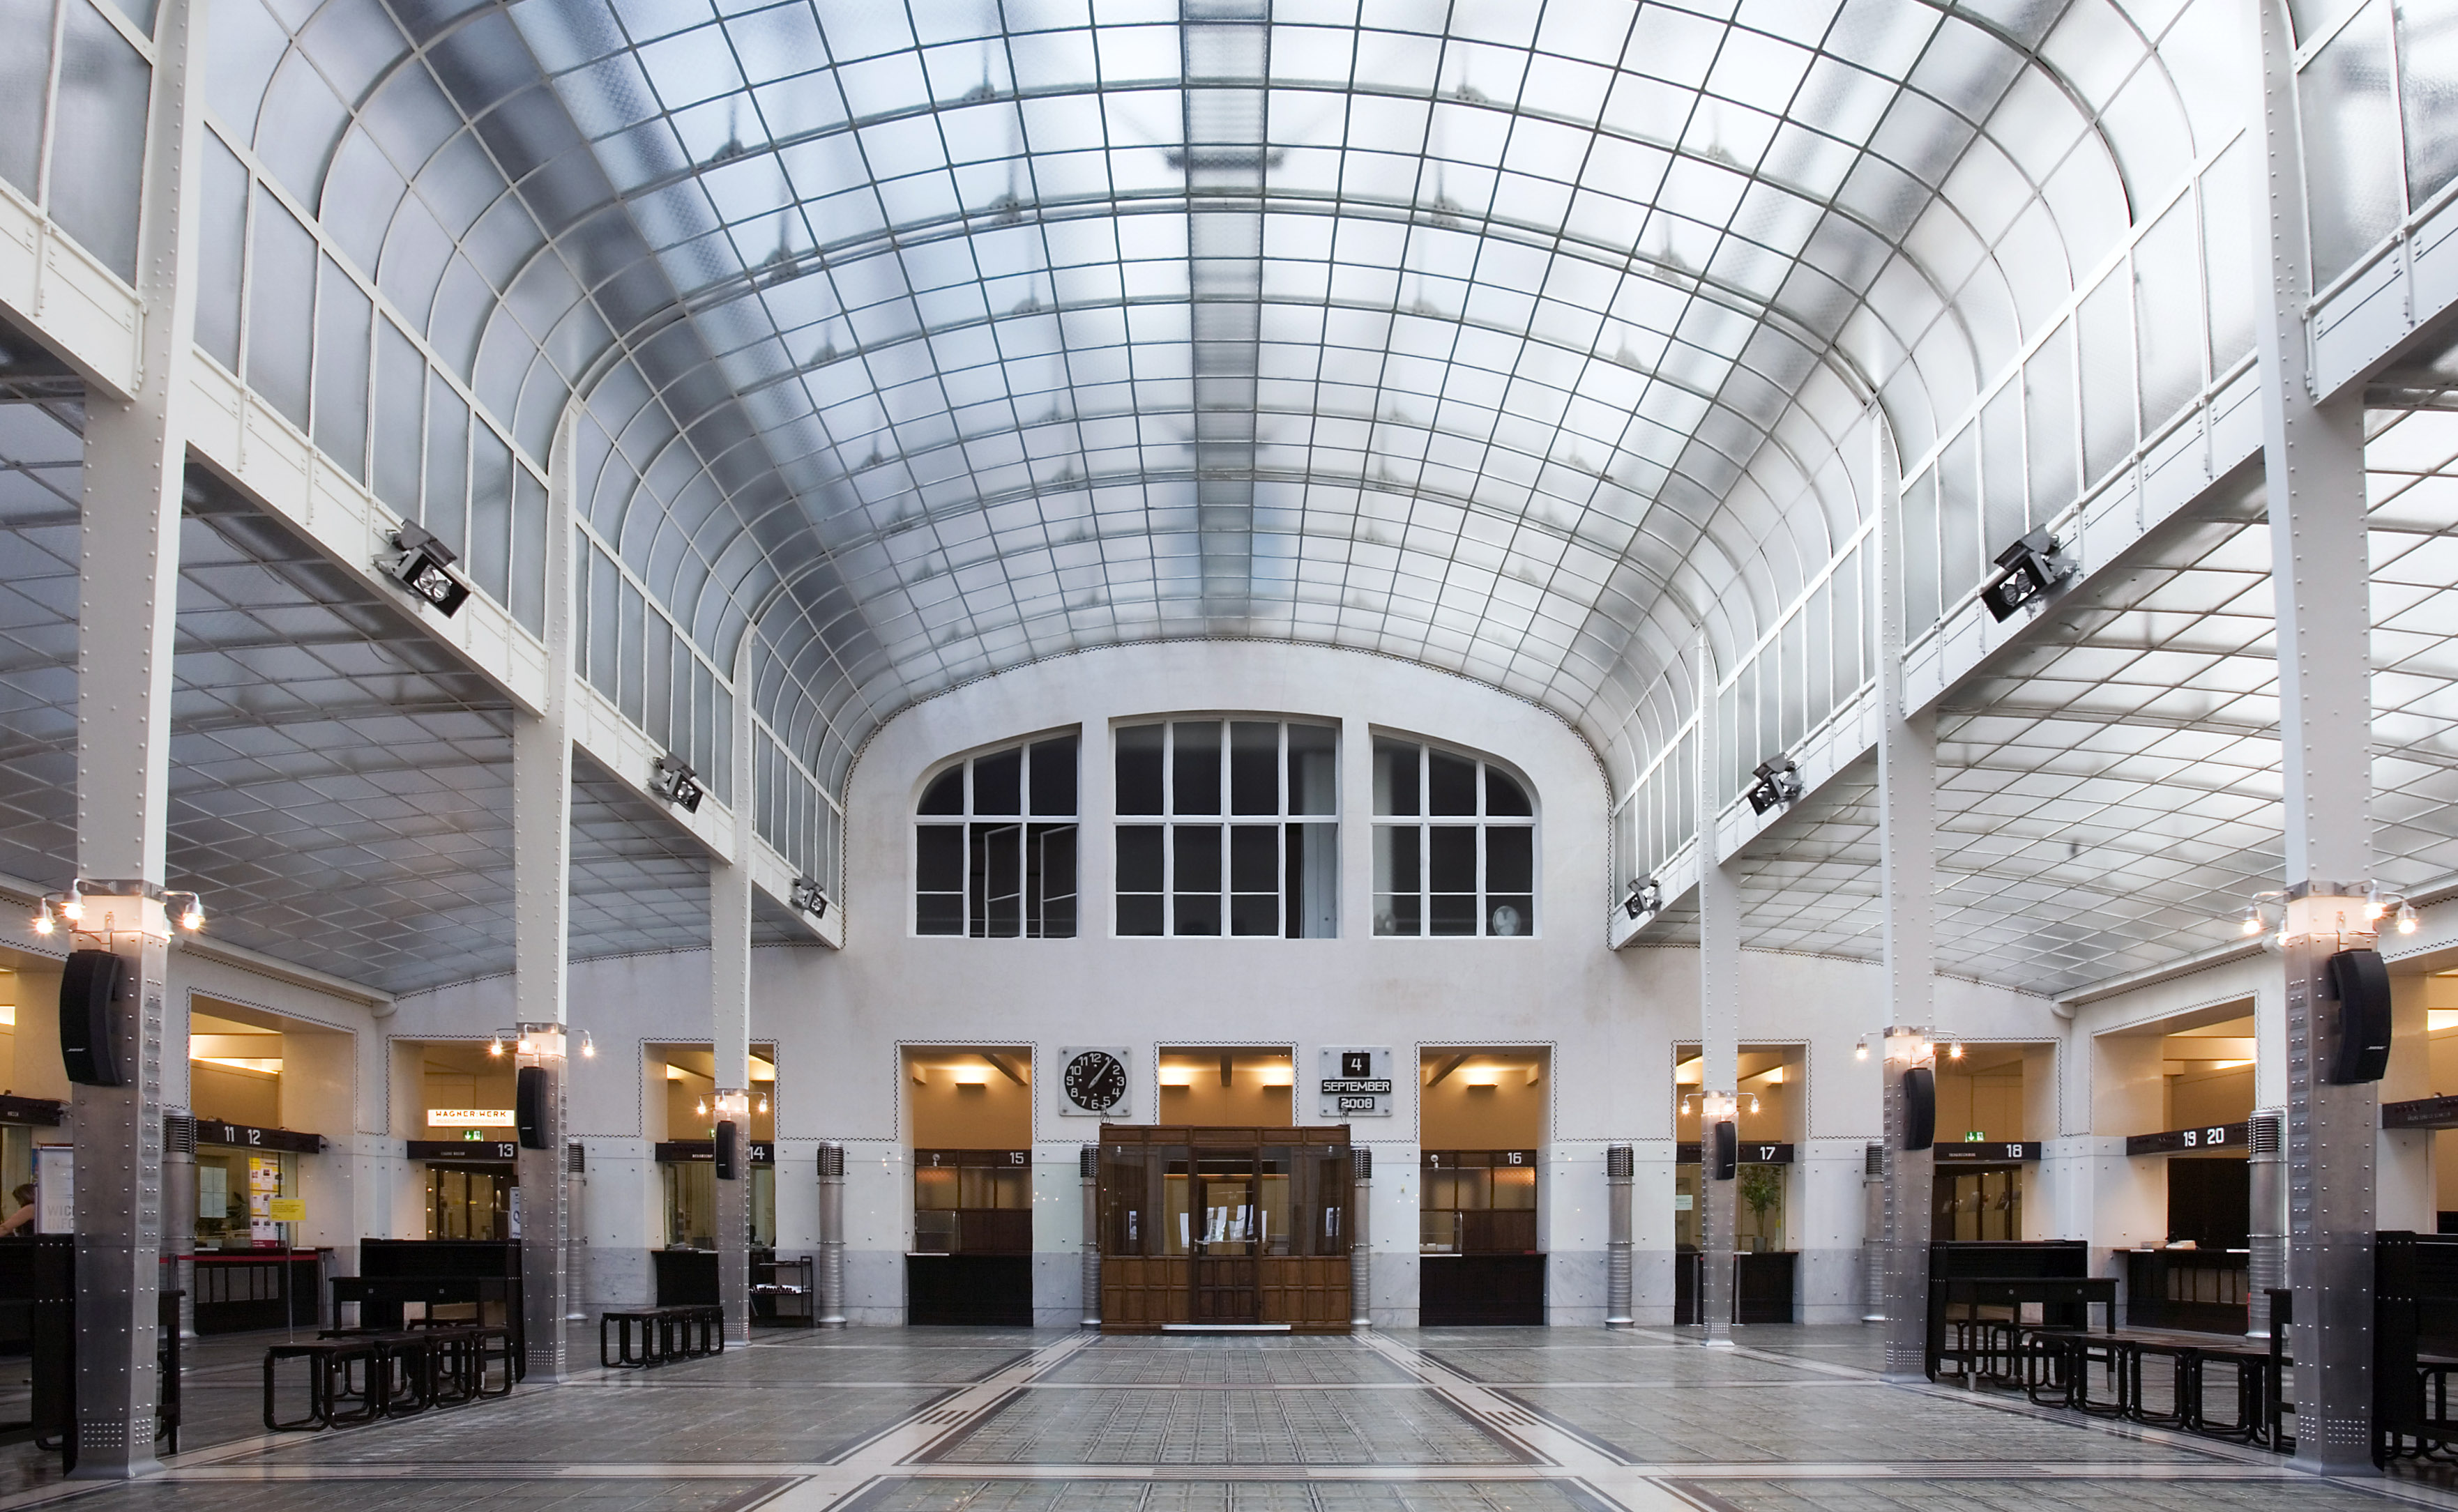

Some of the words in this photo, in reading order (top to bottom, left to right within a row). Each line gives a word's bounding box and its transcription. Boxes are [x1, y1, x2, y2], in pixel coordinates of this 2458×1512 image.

[1079, 1056, 1088, 1066] 11
[1089, 1053, 1101, 1062] 12
[1351, 1058, 1362, 1071] 4
[1069, 1066, 1082, 1075] 10
[1112, 1065, 1120, 1074] 2
[1066, 1076, 1074, 1085] 9
[1116, 1077, 1124, 1086] 3
[1323, 1081, 1390, 1091] SEPTEMBER
[1070, 1088, 1078, 1097] 8
[1112, 1088, 1120, 1097] 4
[1080, 1097, 1087, 1106] 7
[1091, 1100, 1099, 1109] 6
[1103, 1097, 1110, 1106] 5
[1340, 1099, 1372, 1108] 2008
[225, 1126, 234, 1142] 11
[248, 1129, 261, 1145] 12
[2183, 1131, 2196, 1147] 19
[2207, 1127, 2224, 1145] 20
[498, 1144, 514, 1157] 13
[750, 1147, 764, 1159] 14
[1760, 1147, 1775, 1160] 17
[2006, 1144, 2022, 1157] 18
[1010, 1152, 1024, 1163] 15
[1508, 1152, 1522, 1163] 16
